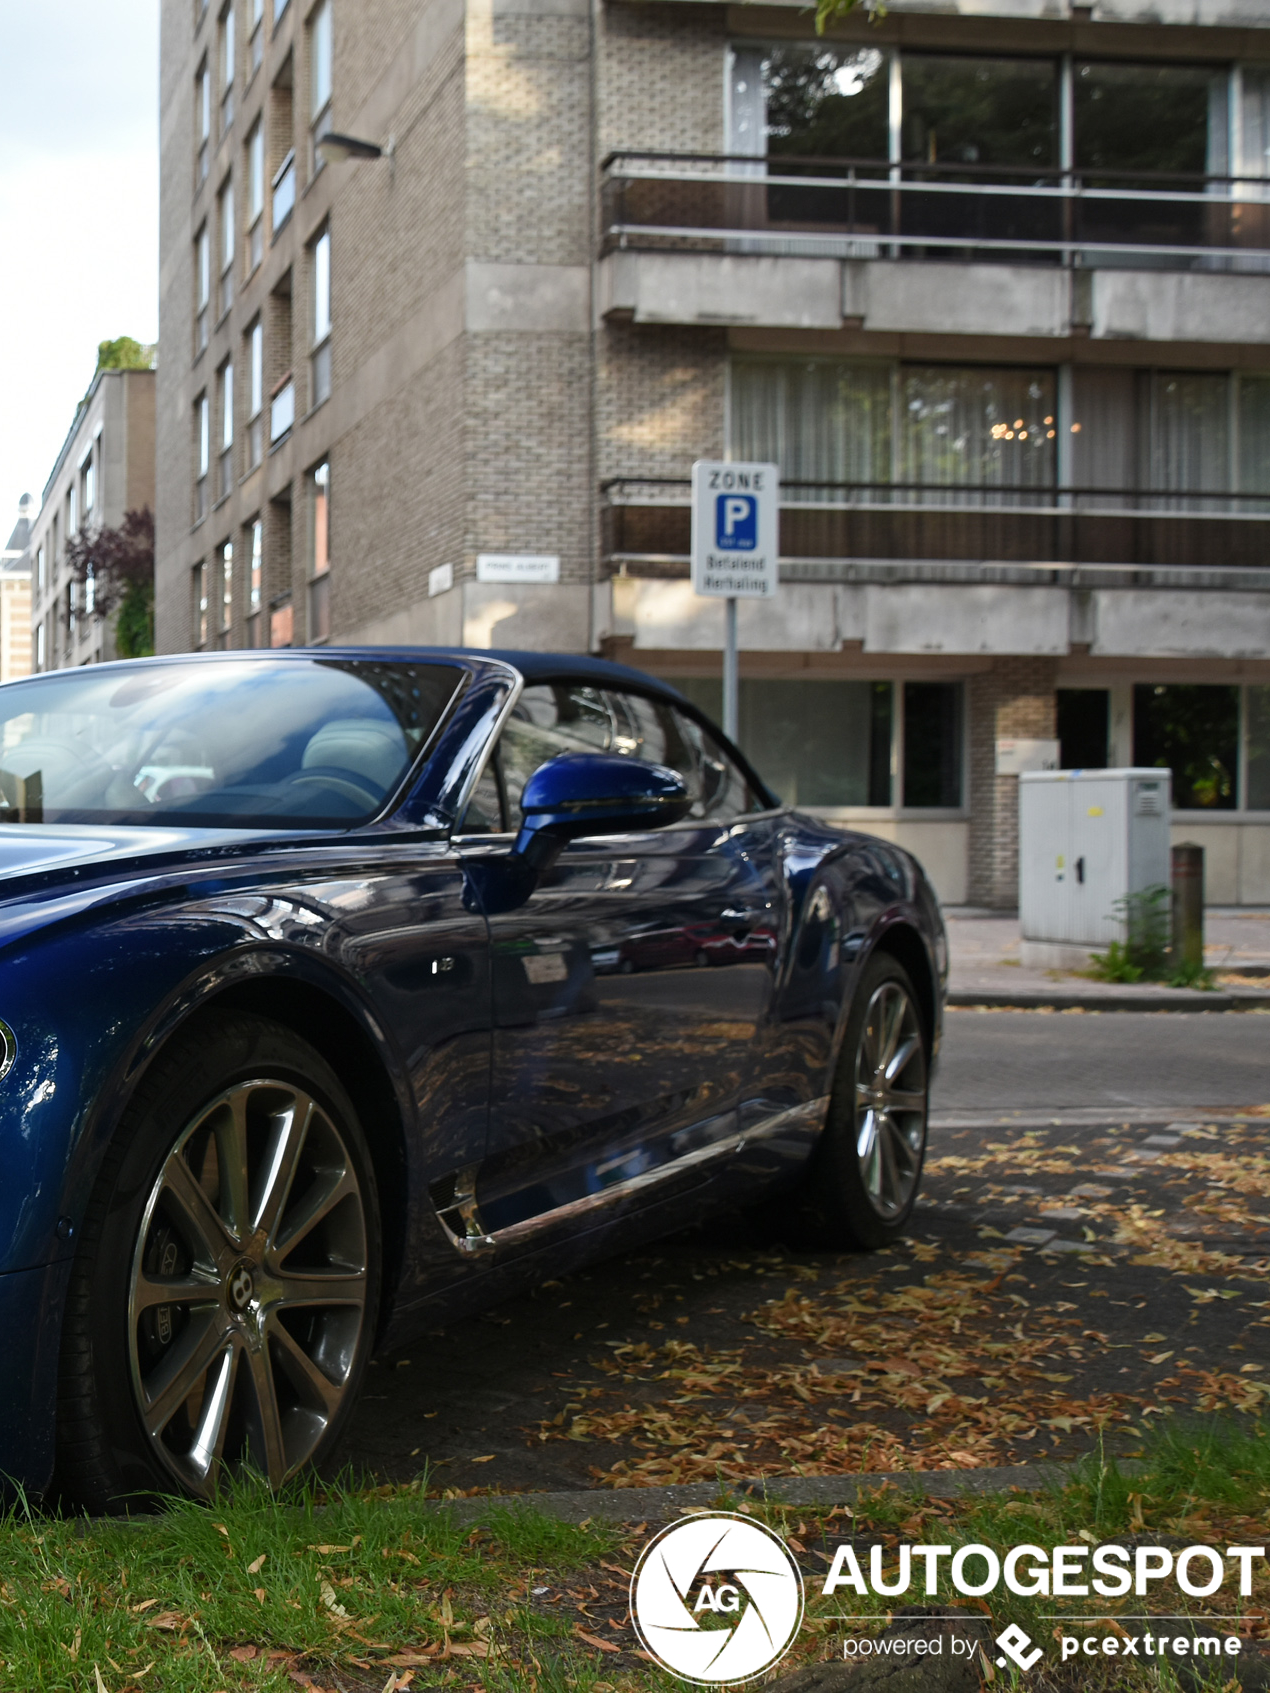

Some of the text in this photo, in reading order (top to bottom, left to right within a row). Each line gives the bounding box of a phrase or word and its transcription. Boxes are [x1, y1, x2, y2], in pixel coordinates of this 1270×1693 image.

[709, 470, 765, 491] ZONE
[724, 497, 751, 536] P
[706, 555, 766, 571] Betalend
[703, 576, 768, 596] Herhaling
